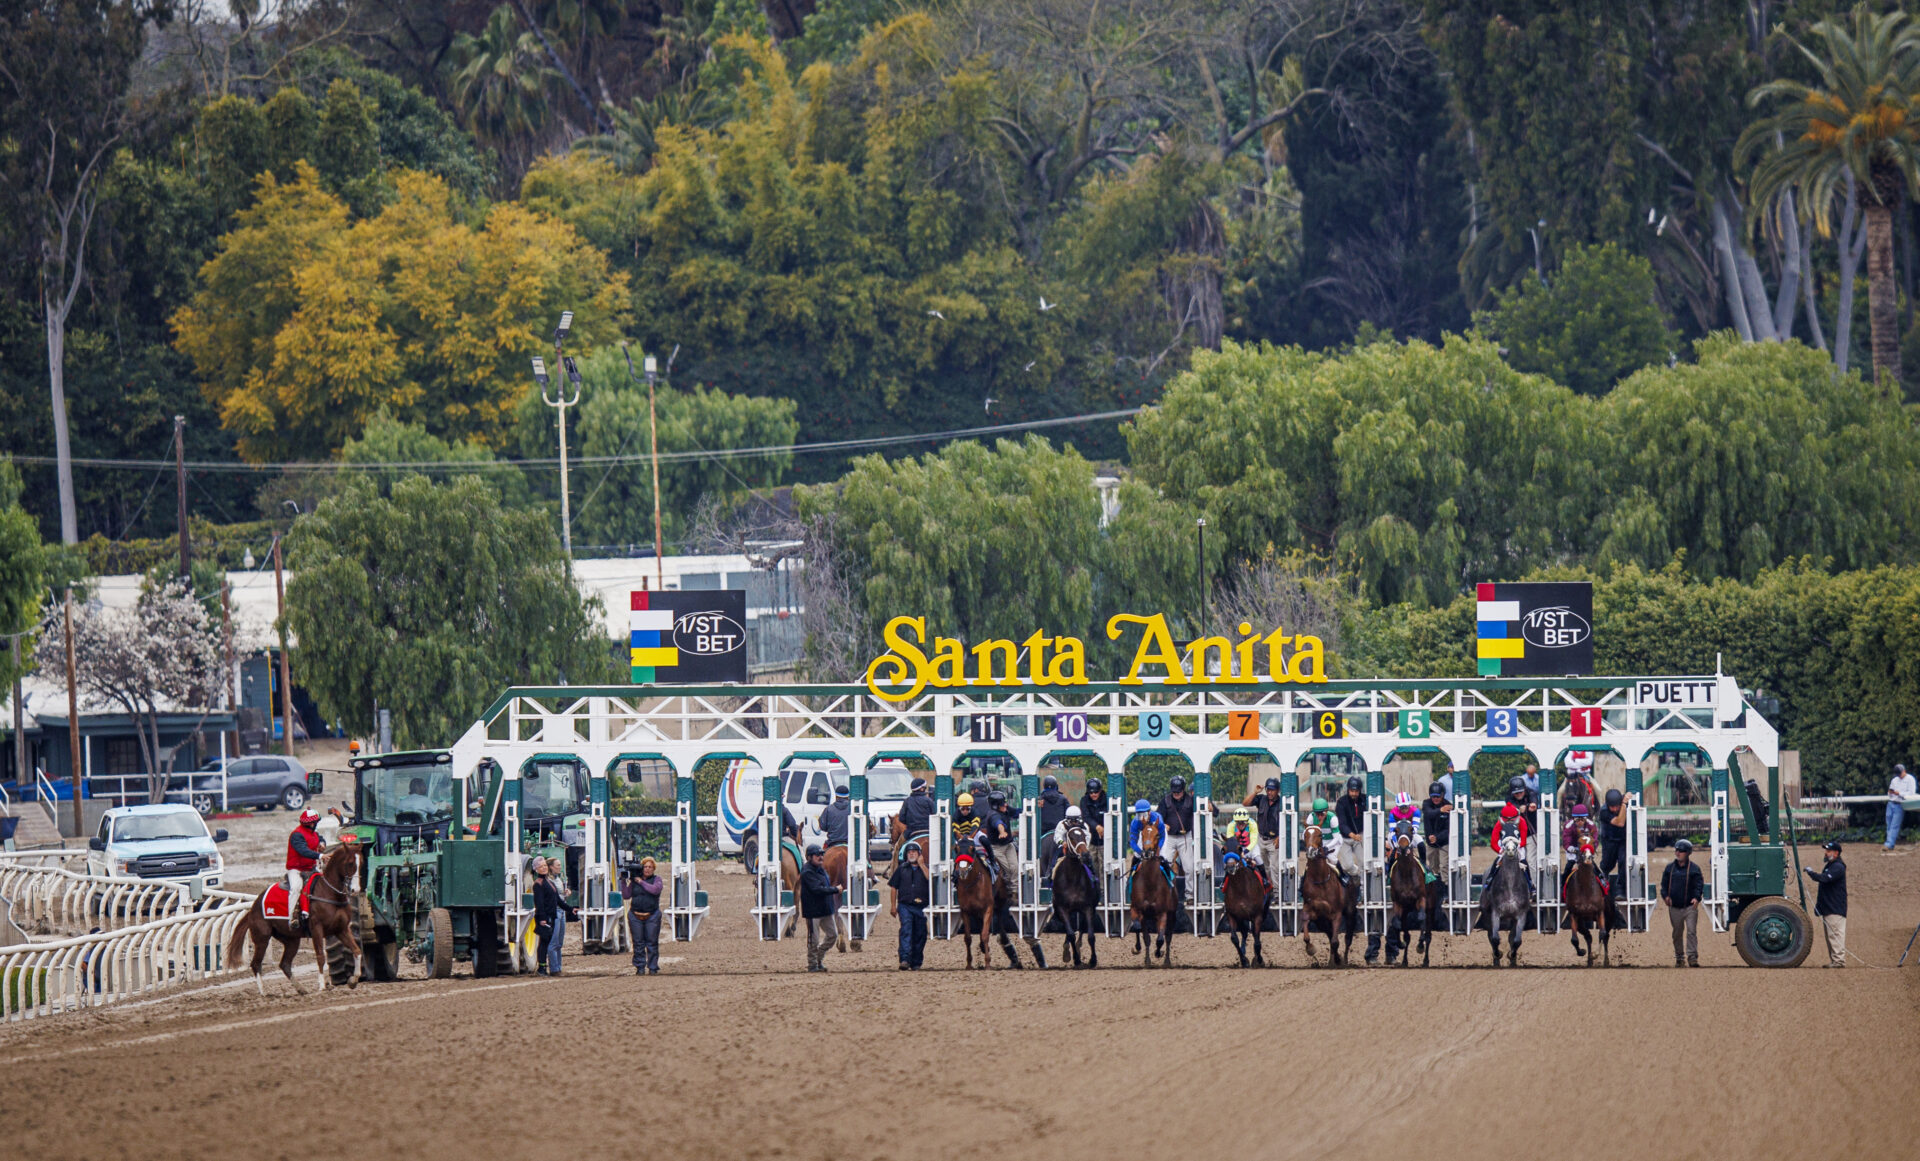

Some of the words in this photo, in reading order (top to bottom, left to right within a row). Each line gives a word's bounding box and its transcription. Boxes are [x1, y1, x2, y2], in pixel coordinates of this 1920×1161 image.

[680, 616, 723, 634] 1/ST
[1529, 611, 1569, 628] 1/ST
[696, 634, 737, 652] BET
[1544, 628, 1582, 645] BET
[867, 616, 1088, 702] Santa
[1106, 613, 1328, 685] Anita
[1640, 682, 1718, 704] PUETT
[975, 715, 996, 739] 11
[1057, 715, 1086, 739] 10
[1147, 713, 1163, 738] 9
[1236, 713, 1253, 737] 7
[1319, 712, 1336, 737] 6
[1406, 711, 1424, 736] 5
[1494, 710, 1511, 736] 3
[1580, 709, 1592, 734] 1
